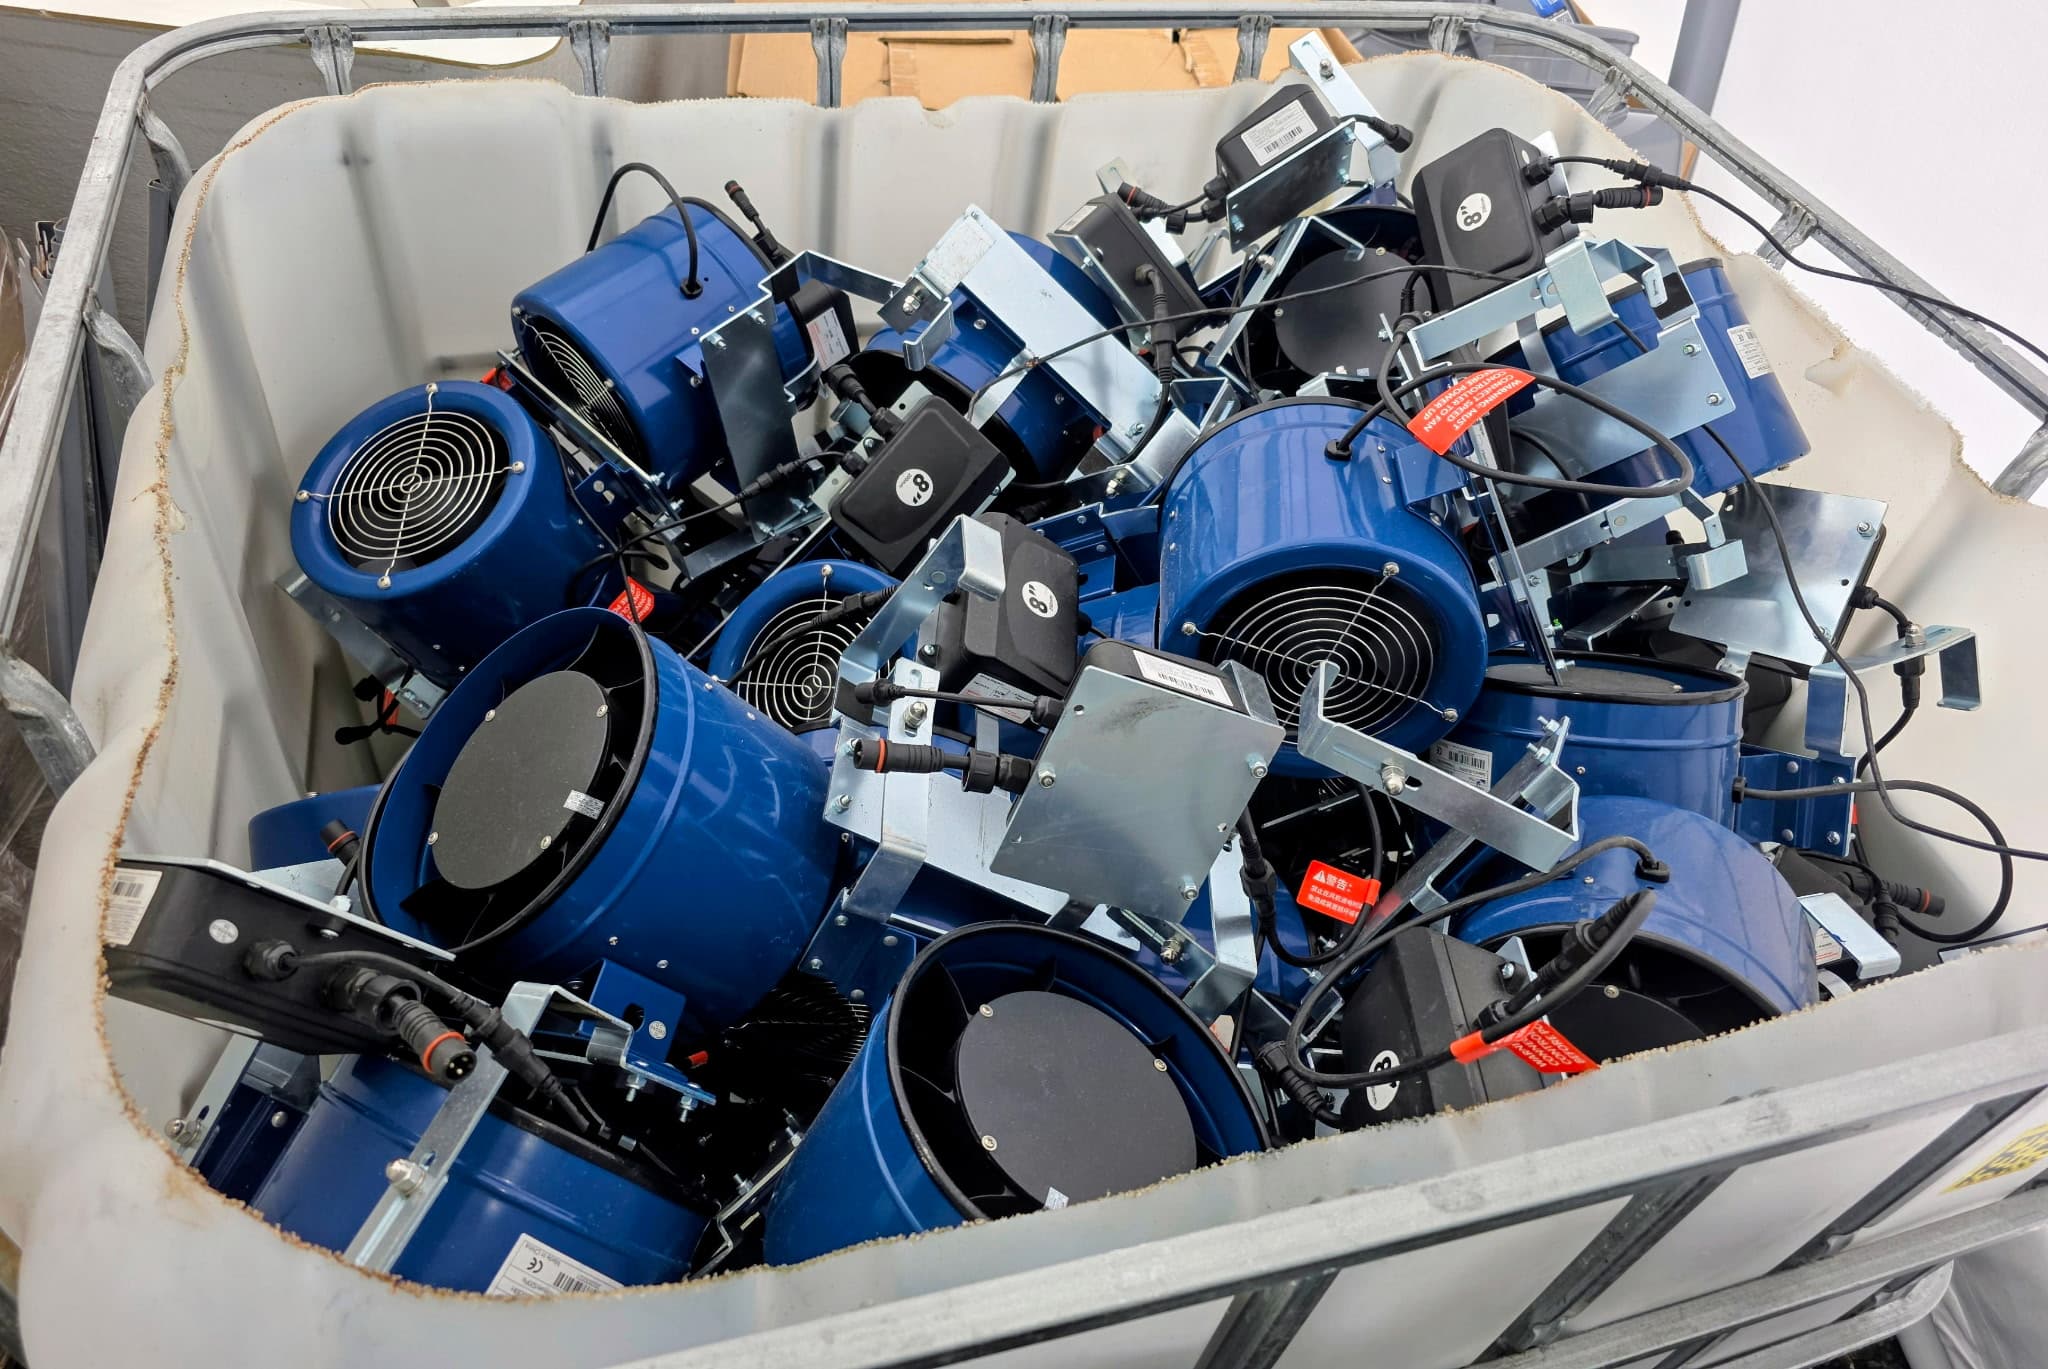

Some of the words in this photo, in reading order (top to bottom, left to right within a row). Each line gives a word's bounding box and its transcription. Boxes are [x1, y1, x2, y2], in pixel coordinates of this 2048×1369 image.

[1441, 384, 1467, 409] POWER
[1452, 371, 1507, 406] CONTROLLER
[1473, 374, 1514, 402] CONNECT
[1479, 379, 1523, 408] WARNING:
[1423, 407, 1437, 421] UP
[1440, 403, 1455, 417] TO
[1446, 401, 1473, 423] SPEED
[1452, 409, 1478, 431] MUST
[1423, 416, 1442, 432] FAN
[1511, 1042, 1547, 1068] WARNI
[1549, 1036, 1586, 1064] BEFORE
[526, 1257, 544, 1274] CE
